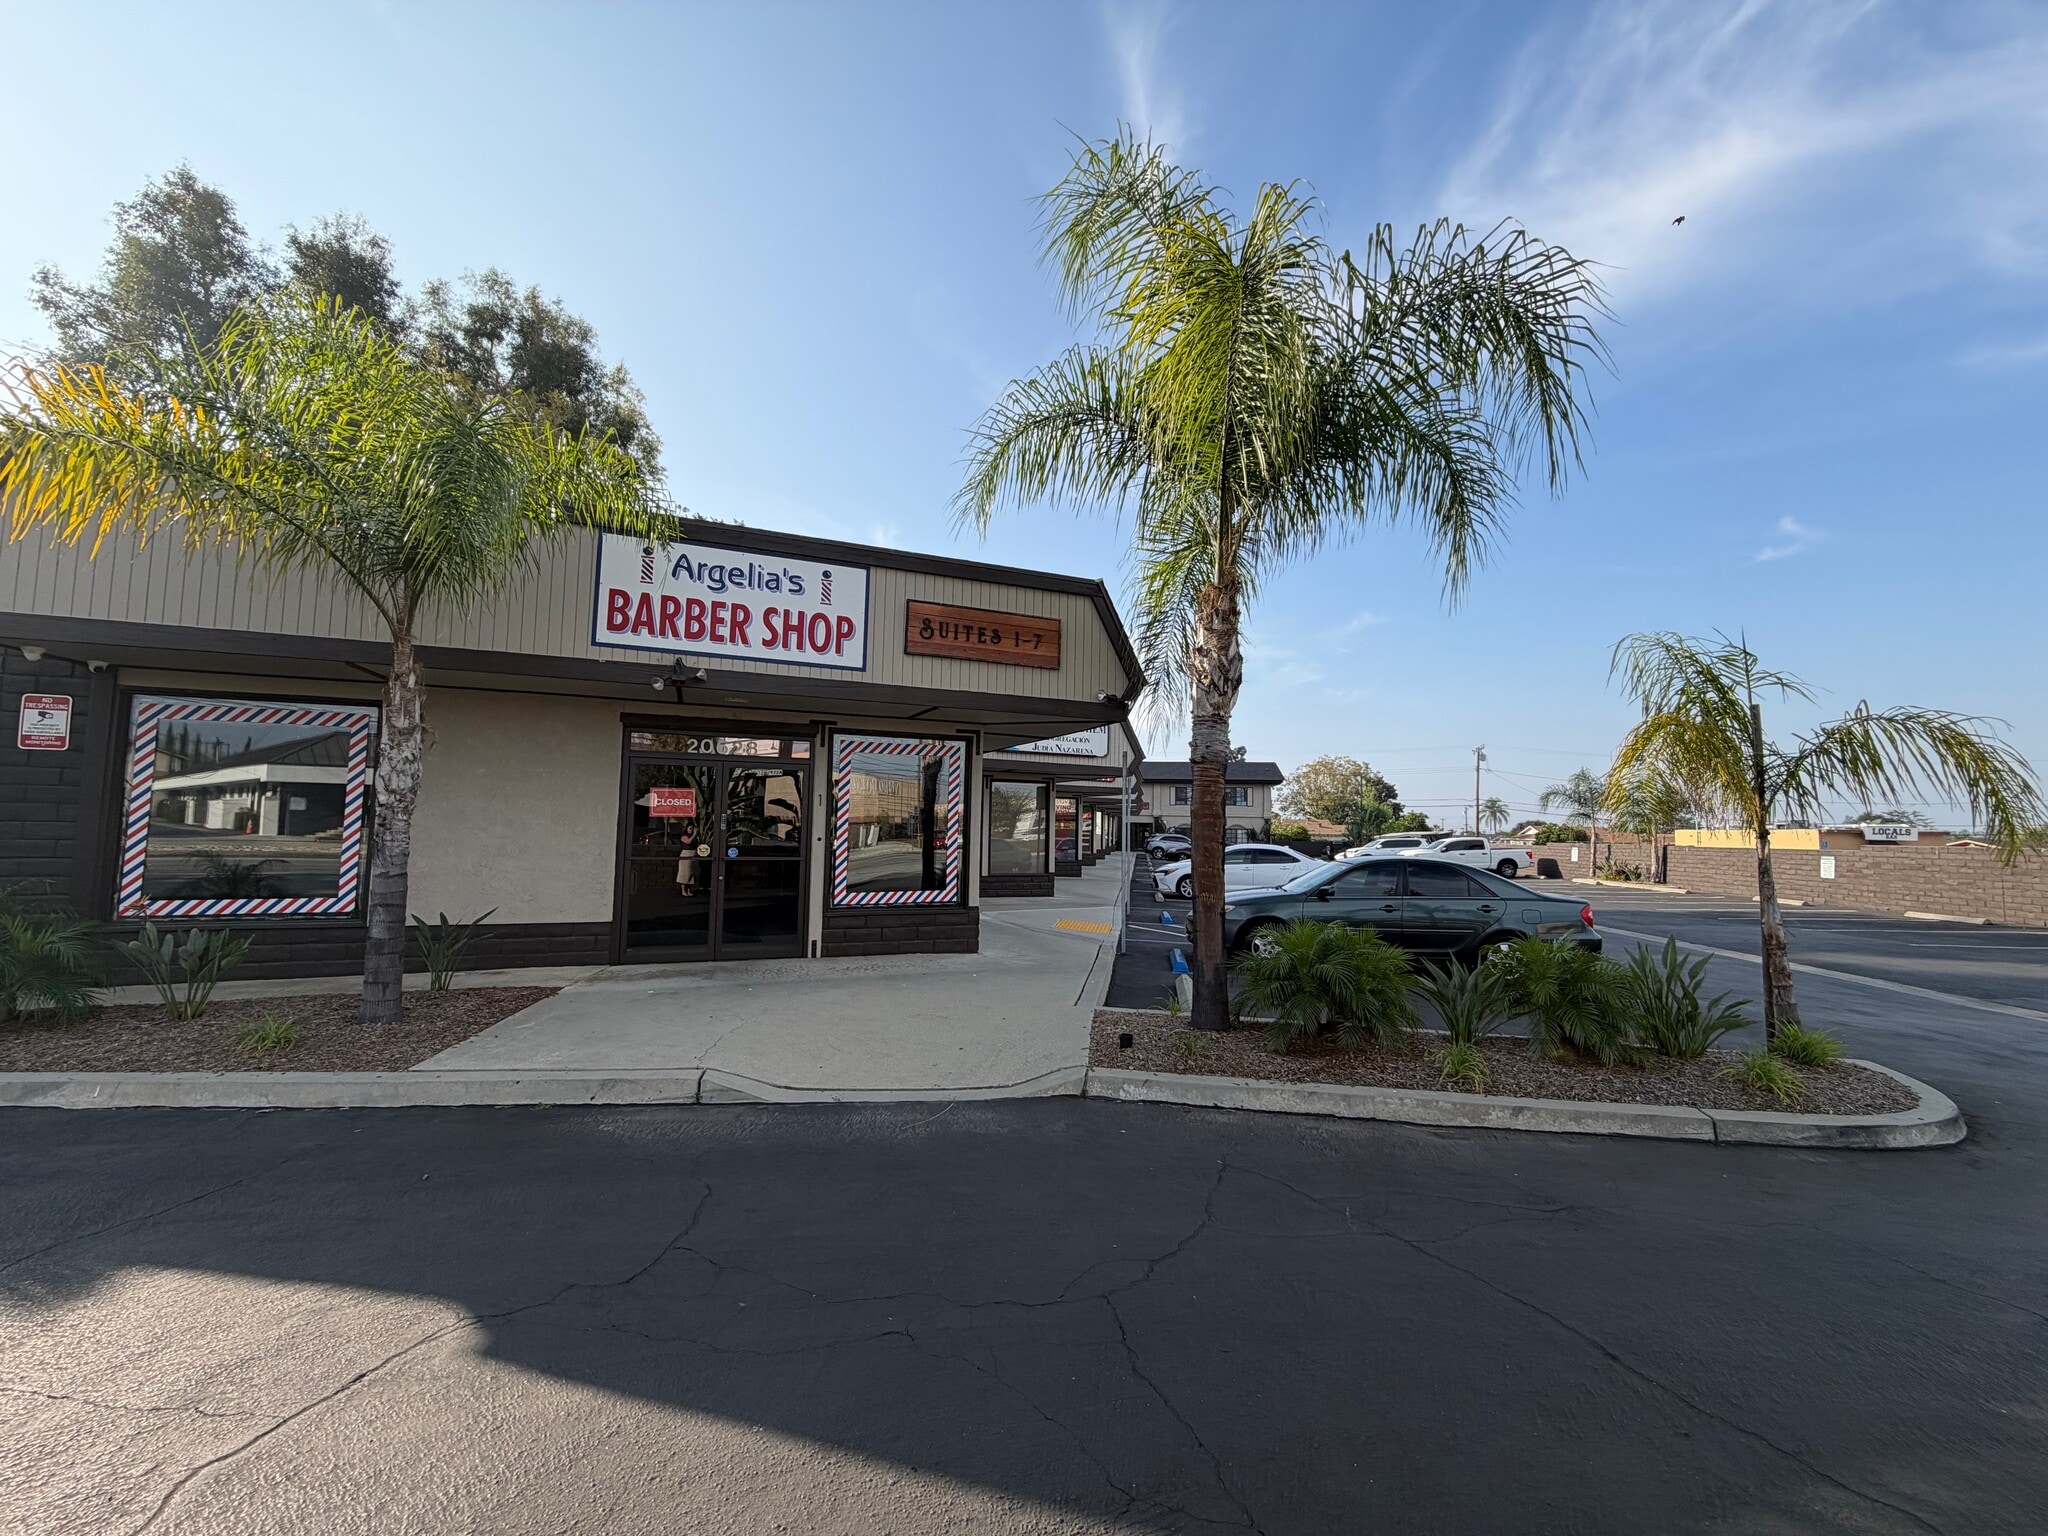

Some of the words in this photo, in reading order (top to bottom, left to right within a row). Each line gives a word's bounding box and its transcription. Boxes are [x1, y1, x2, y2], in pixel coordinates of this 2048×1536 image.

[671, 553, 805, 595] Argelia's
[606, 588, 752, 646] BARBER
[761, 607, 856, 656] SHOP
[1014, 631, 1044, 650] 1-7
[686, 738, 758, 756] 20628
[655, 798, 692, 807] CLOSED
[1872, 827, 1911, 836] LOCALS
